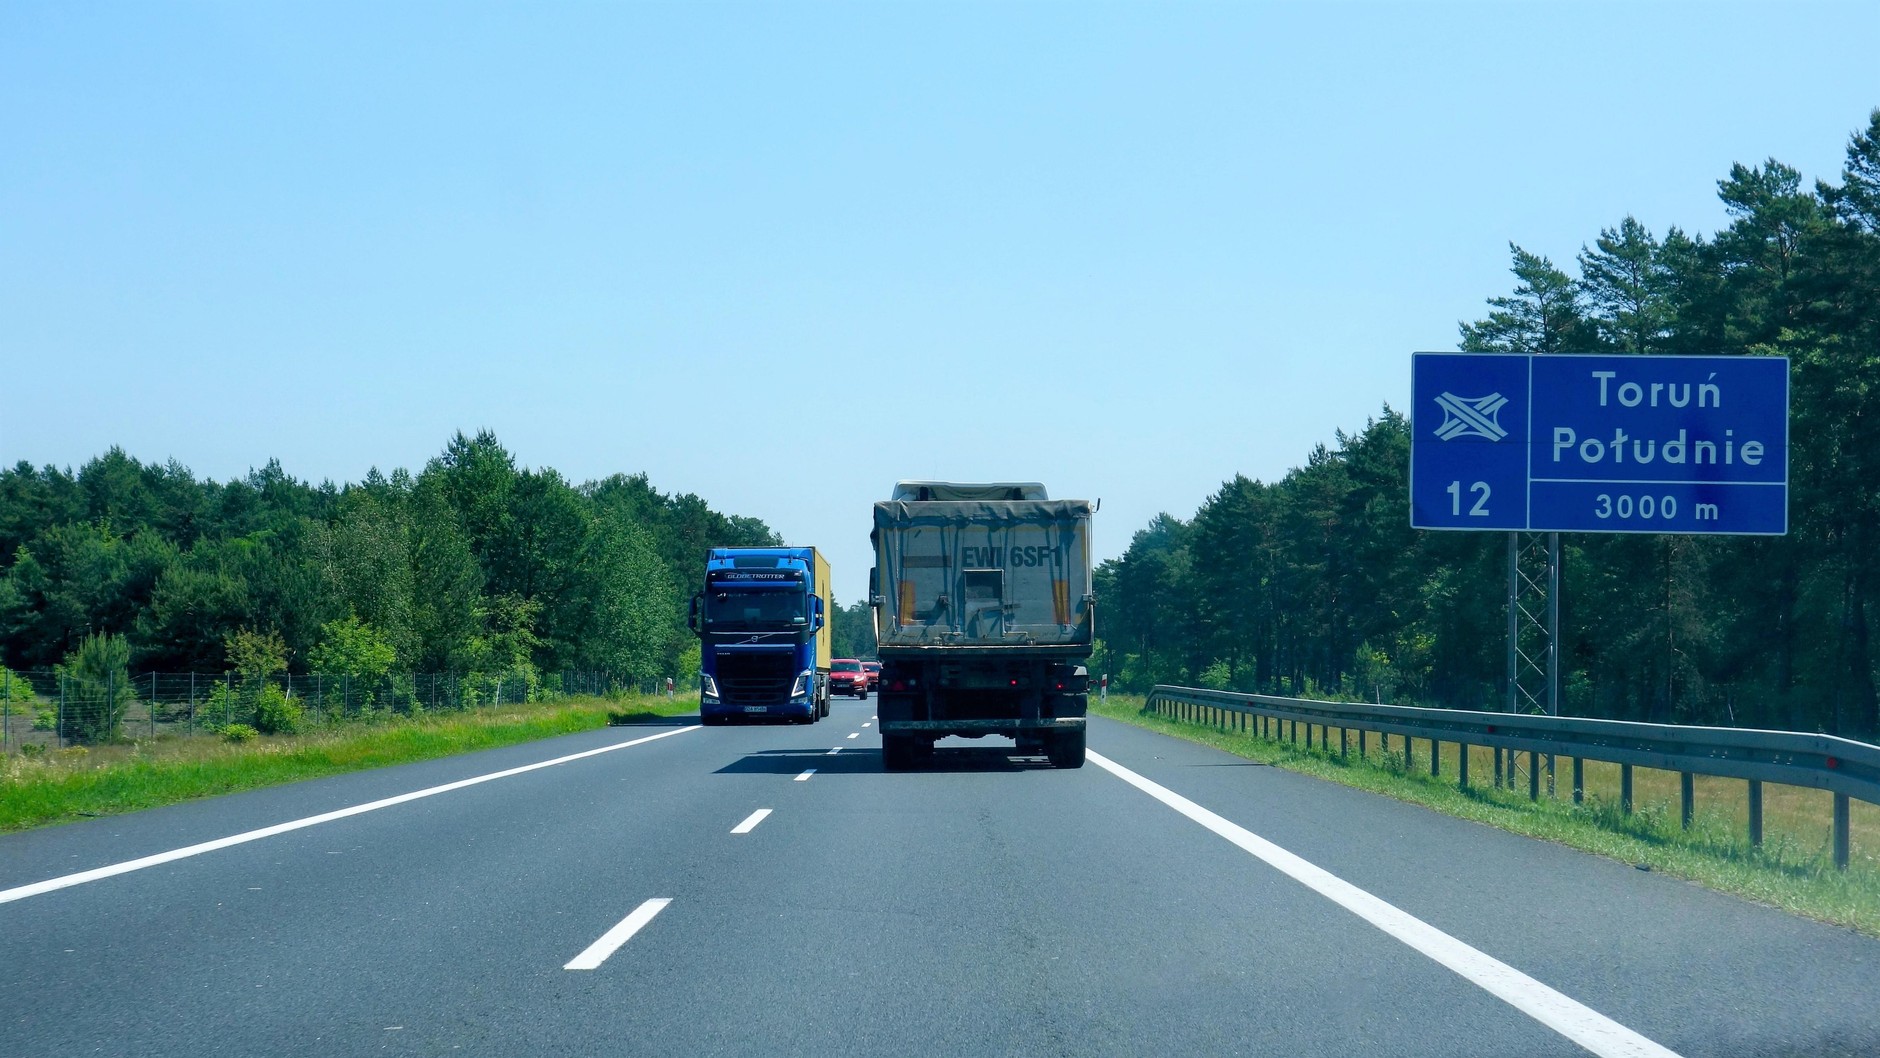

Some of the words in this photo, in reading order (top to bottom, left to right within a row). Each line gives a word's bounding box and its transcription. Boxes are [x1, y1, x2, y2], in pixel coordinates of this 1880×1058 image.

[1592, 371, 1721, 408] Toruń
[1553, 427, 1765, 466] Południe
[1446, 481, 1492, 516] 12
[1595, 494, 1678, 520] 3000
[1695, 503, 1719, 521] m
[962, 546, 1003, 568] EWI
[1010, 545, 1062, 568] 6SF1
